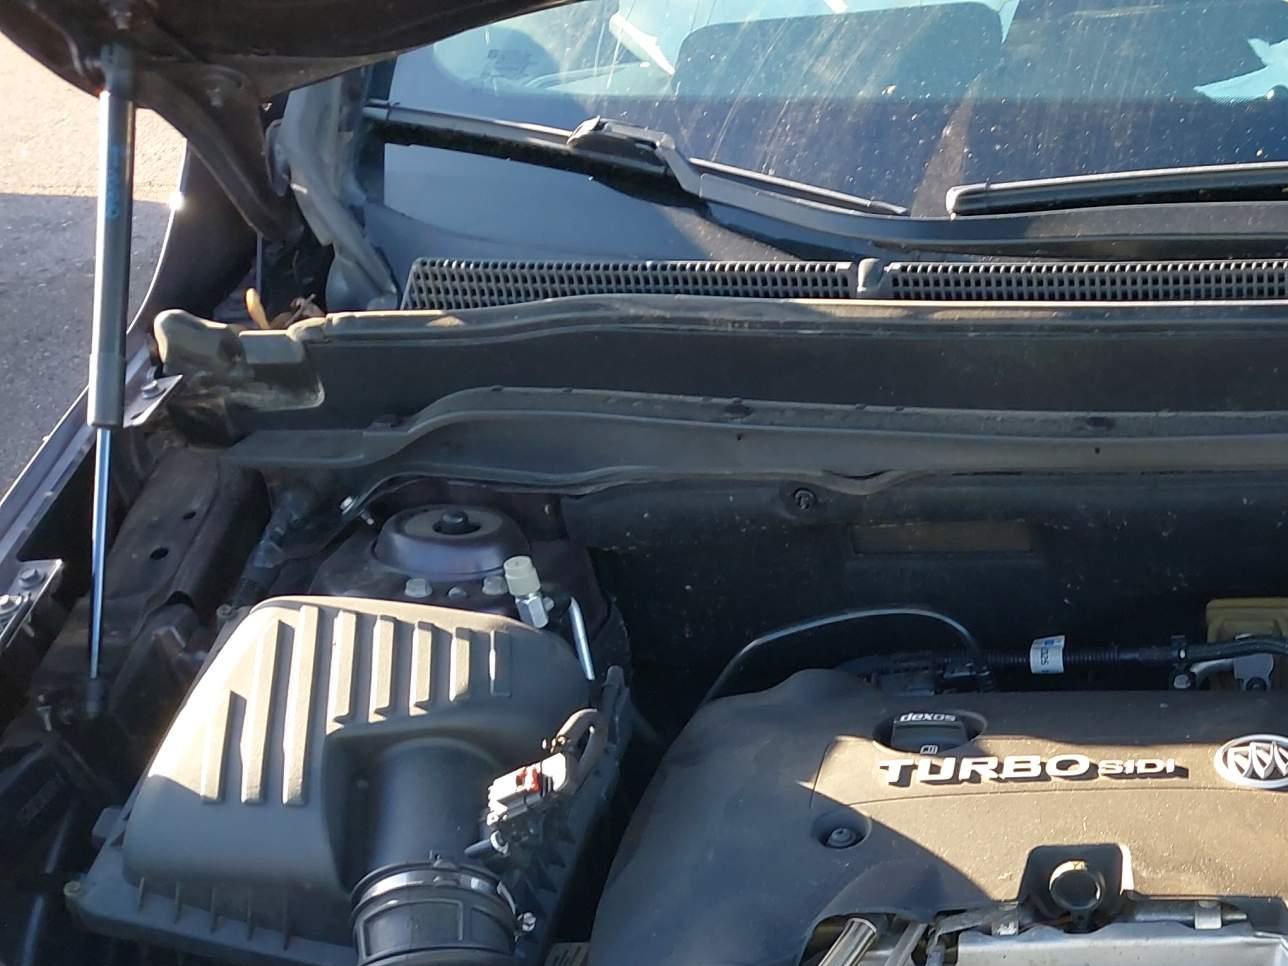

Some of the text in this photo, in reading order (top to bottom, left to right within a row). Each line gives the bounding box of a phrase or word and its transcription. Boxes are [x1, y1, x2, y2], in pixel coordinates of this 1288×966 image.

[900, 711, 957, 723] dexos
[879, 753, 1176, 784] TURBO SIDI
